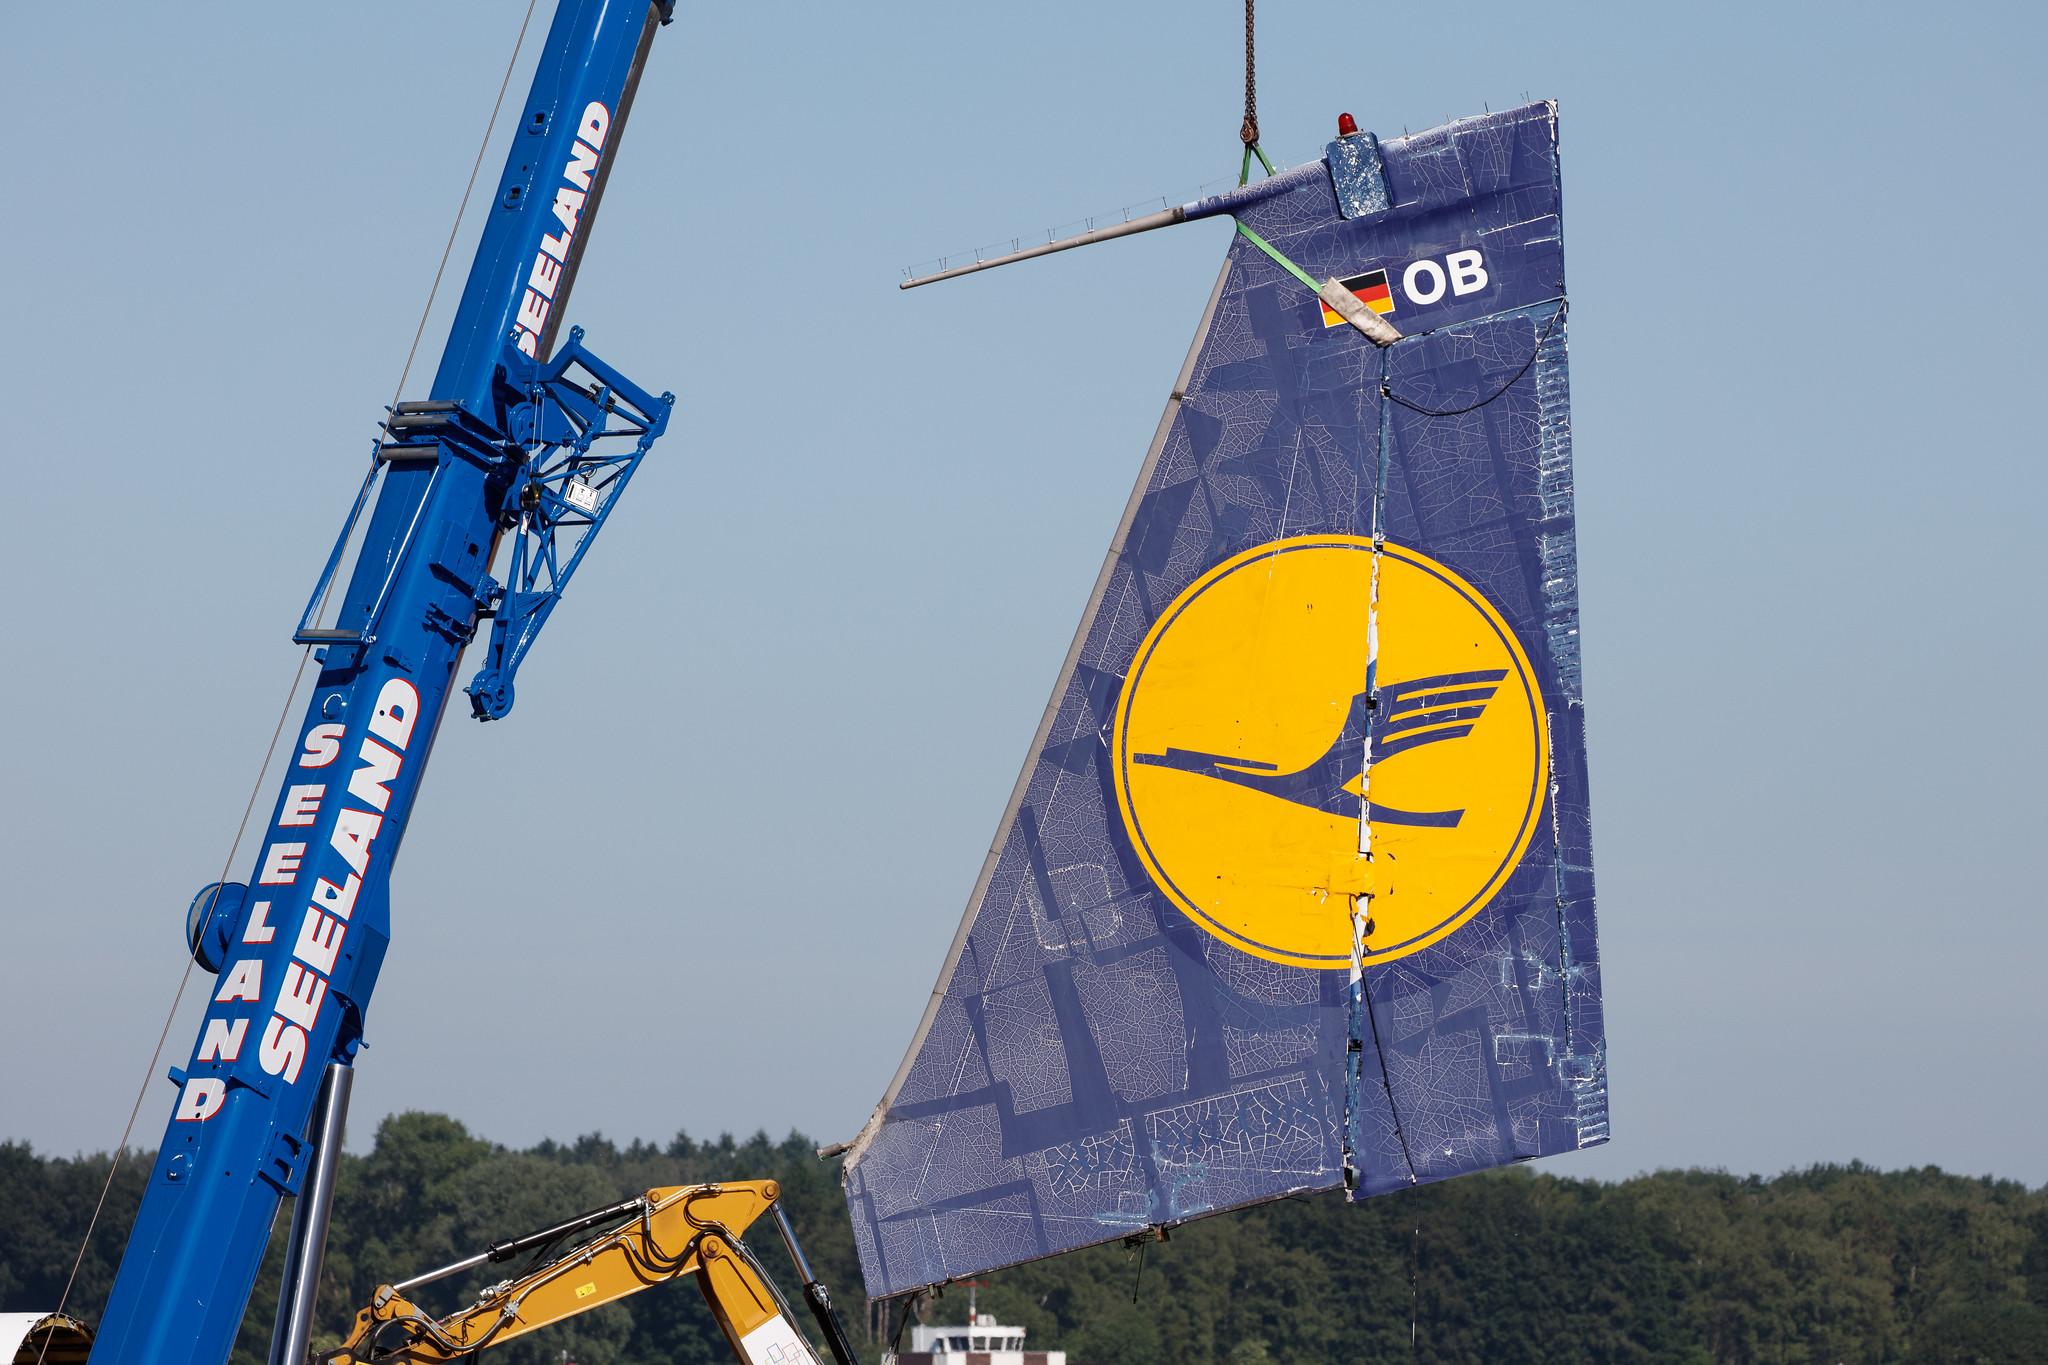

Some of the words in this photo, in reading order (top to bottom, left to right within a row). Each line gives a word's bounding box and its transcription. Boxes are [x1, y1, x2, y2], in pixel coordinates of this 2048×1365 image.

[1403, 249, 1489, 305] OB
[175, 723, 346, 1122] SEELAND
[259, 678, 420, 1085] SEELAND
